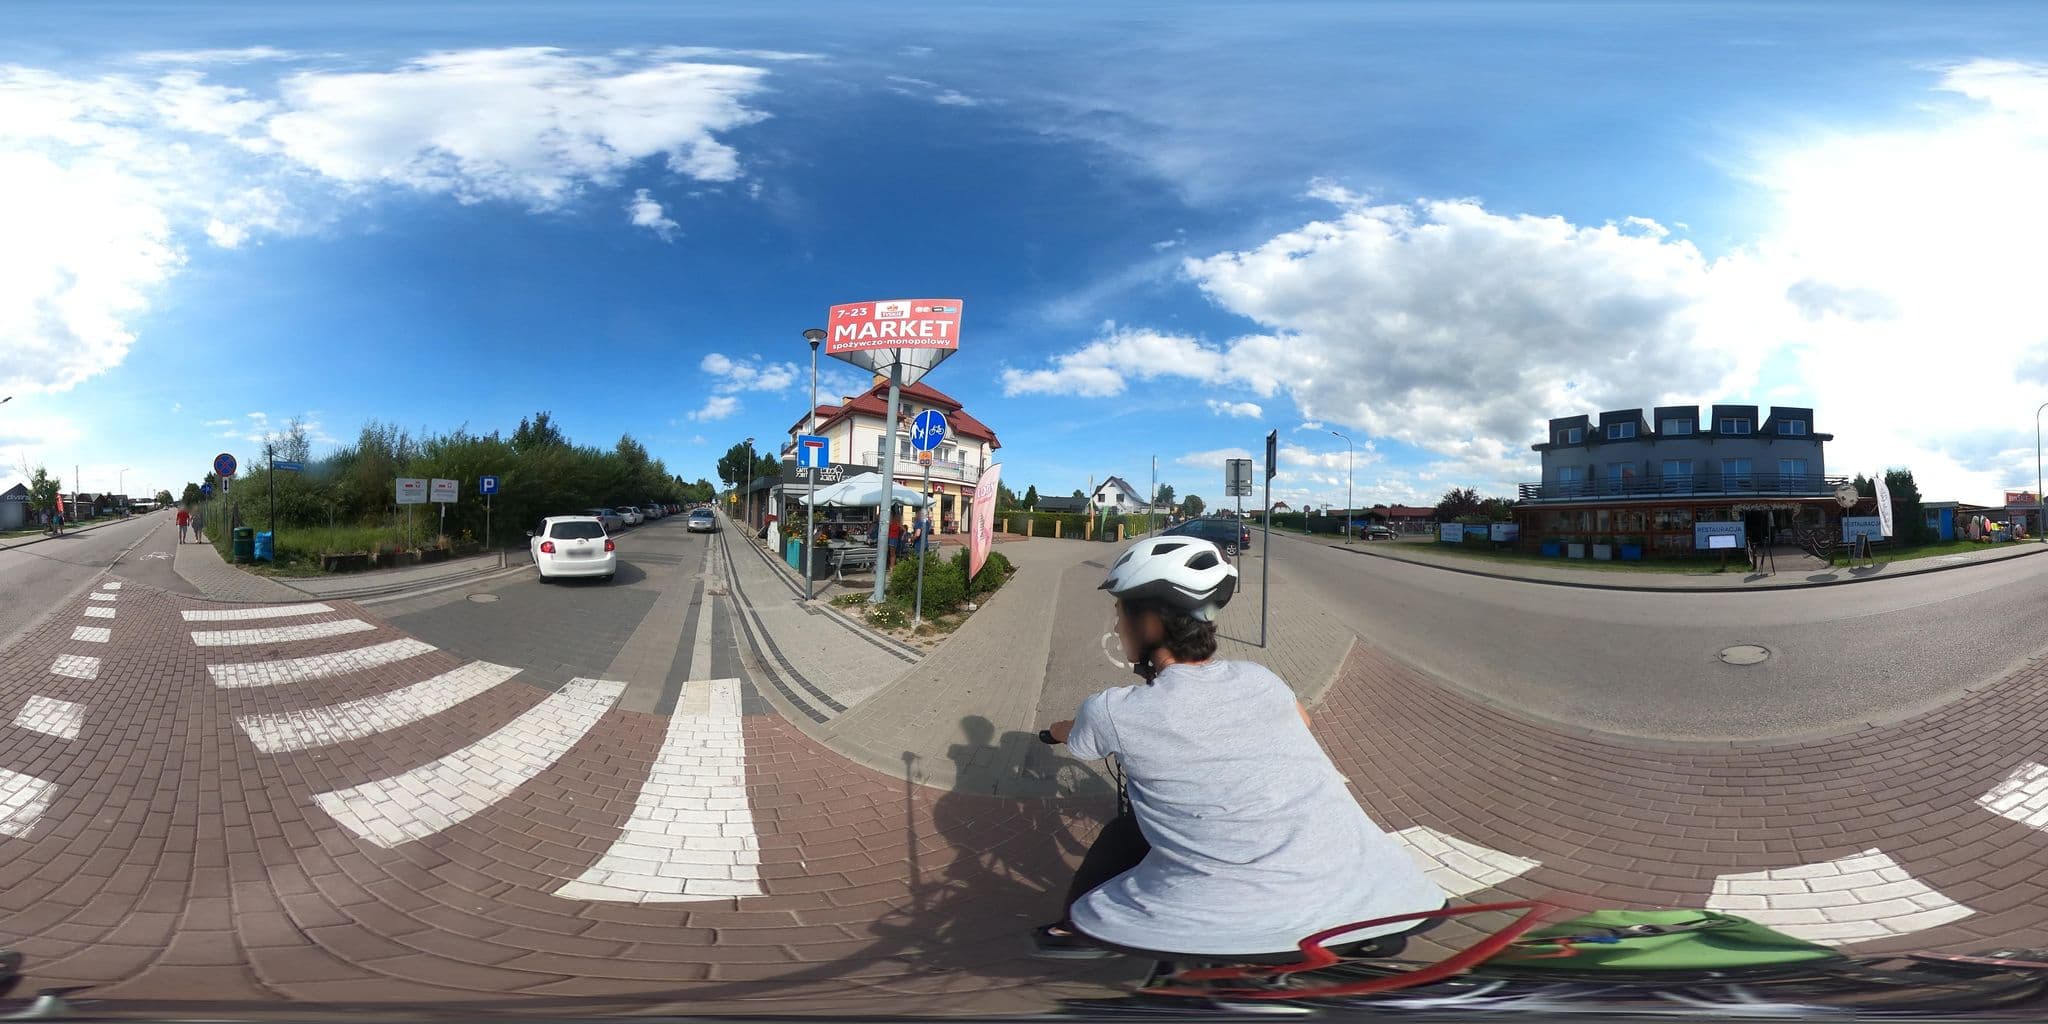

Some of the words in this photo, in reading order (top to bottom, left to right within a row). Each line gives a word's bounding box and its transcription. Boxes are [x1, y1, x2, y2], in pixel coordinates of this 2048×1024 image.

[837, 307, 868, 319] 7-23
[834, 320, 954, 342] MARKET
[483, 478, 495, 492] P
